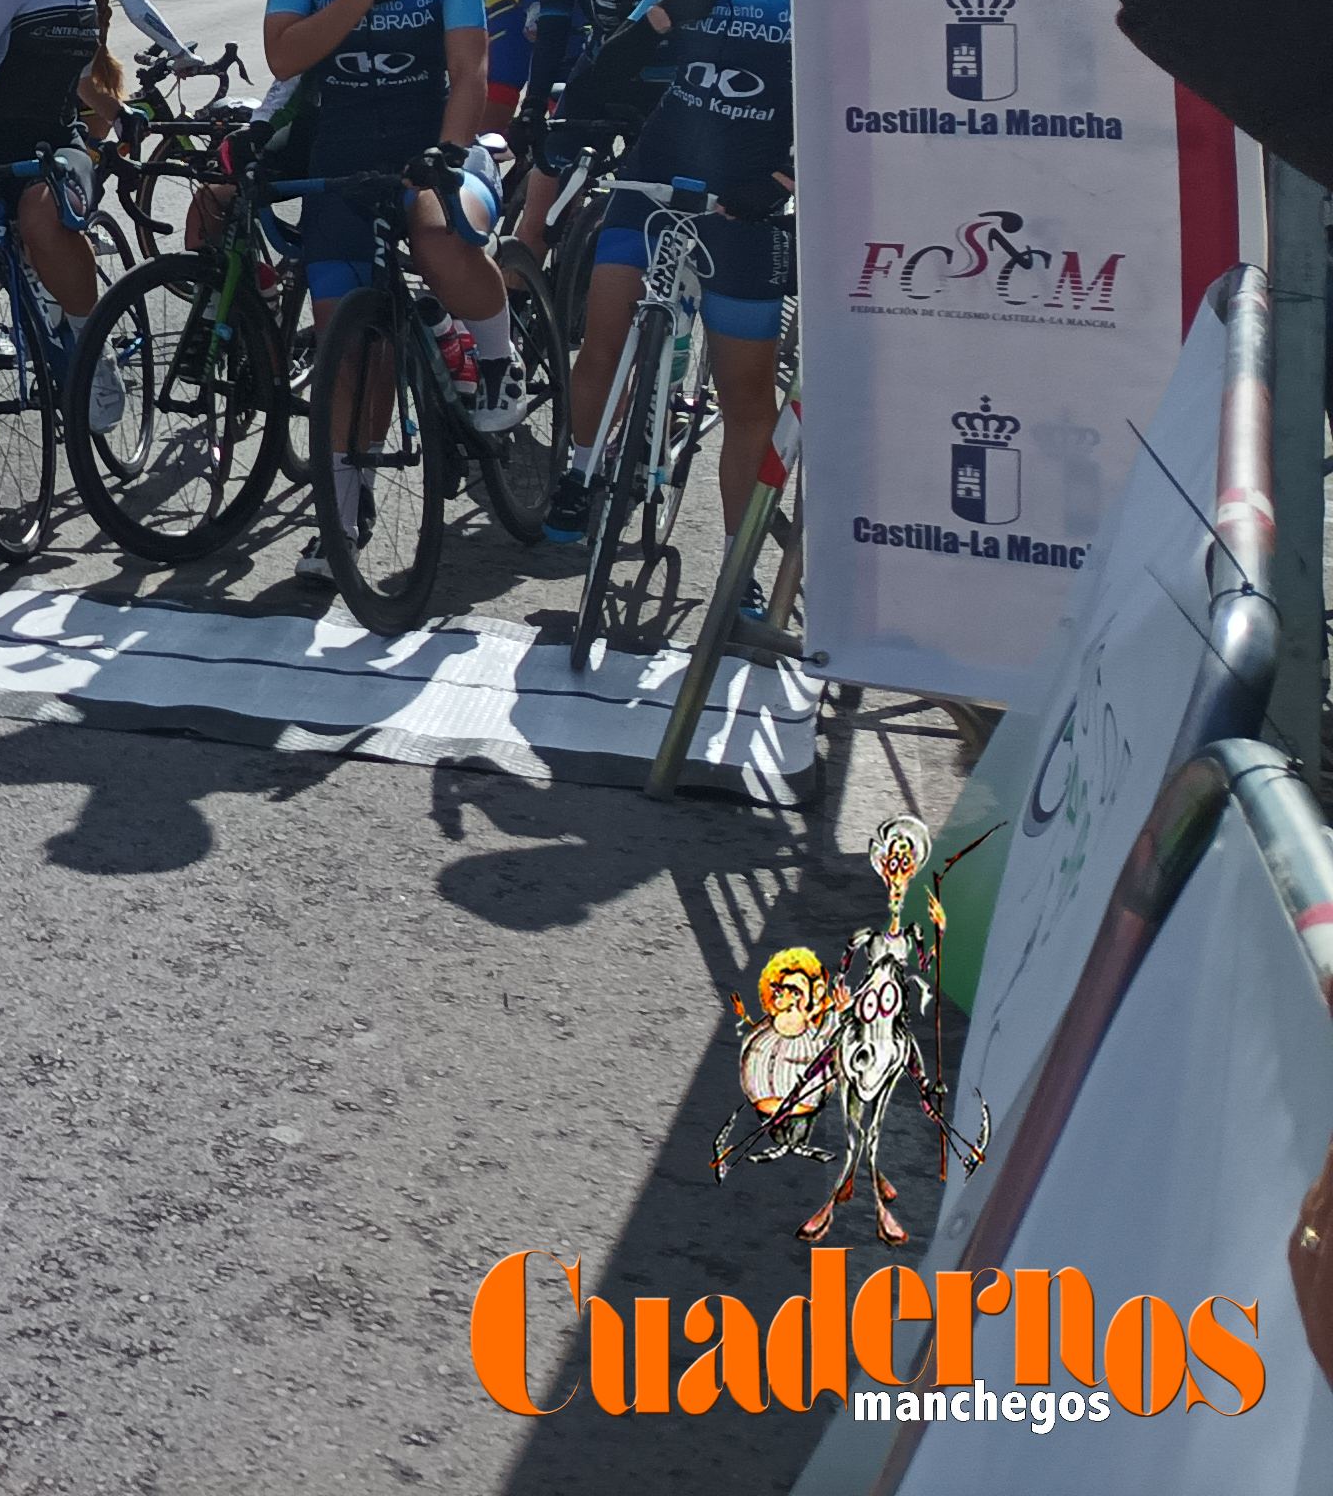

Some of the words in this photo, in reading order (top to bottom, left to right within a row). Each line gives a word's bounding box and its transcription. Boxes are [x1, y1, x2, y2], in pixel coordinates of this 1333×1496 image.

[709, 98, 775, 122] Kapital
[845, 106, 998, 135] Castilla-La
[1006, 110, 1123, 141] Mancha
[921, 307, 935, 318] DE
[853, 516, 1000, 561] Castilla-La
